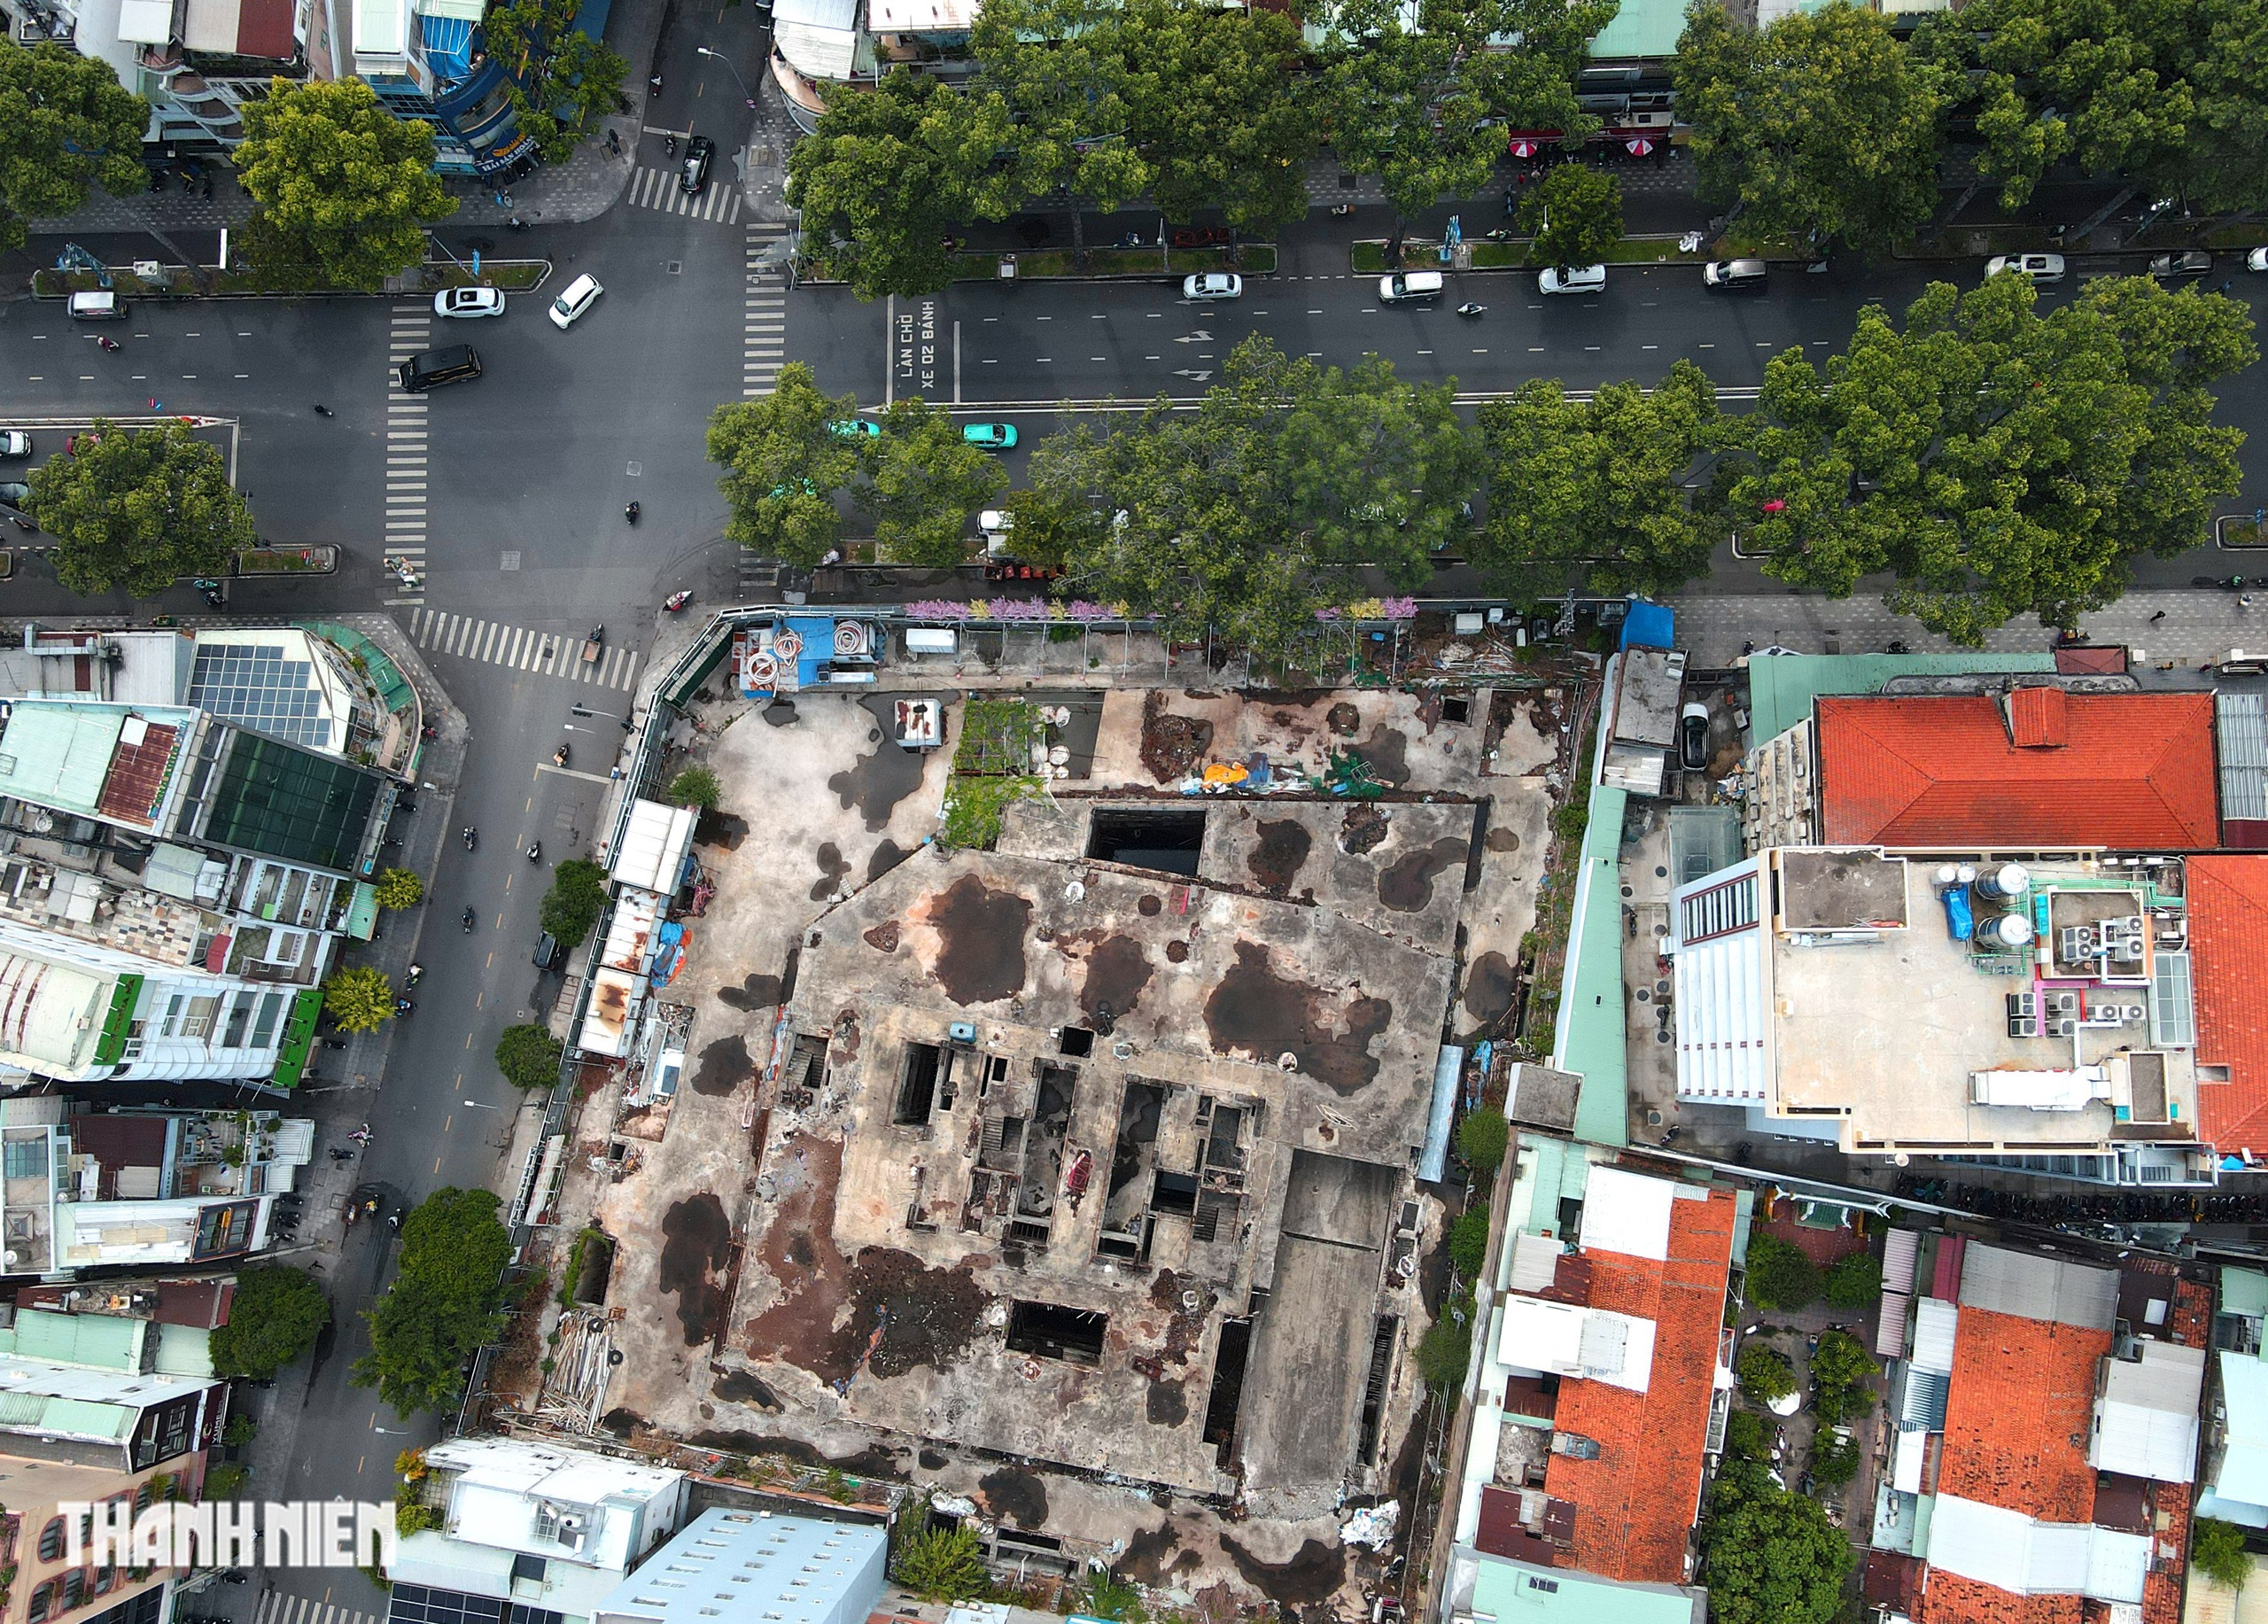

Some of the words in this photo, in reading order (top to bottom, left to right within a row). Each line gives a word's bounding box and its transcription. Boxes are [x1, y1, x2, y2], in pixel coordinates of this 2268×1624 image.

[918, 301, 935, 339] BÁNH
[896, 349, 913, 377] LÀN
[921, 345, 934, 364] 02
[921, 370, 934, 389] XE
